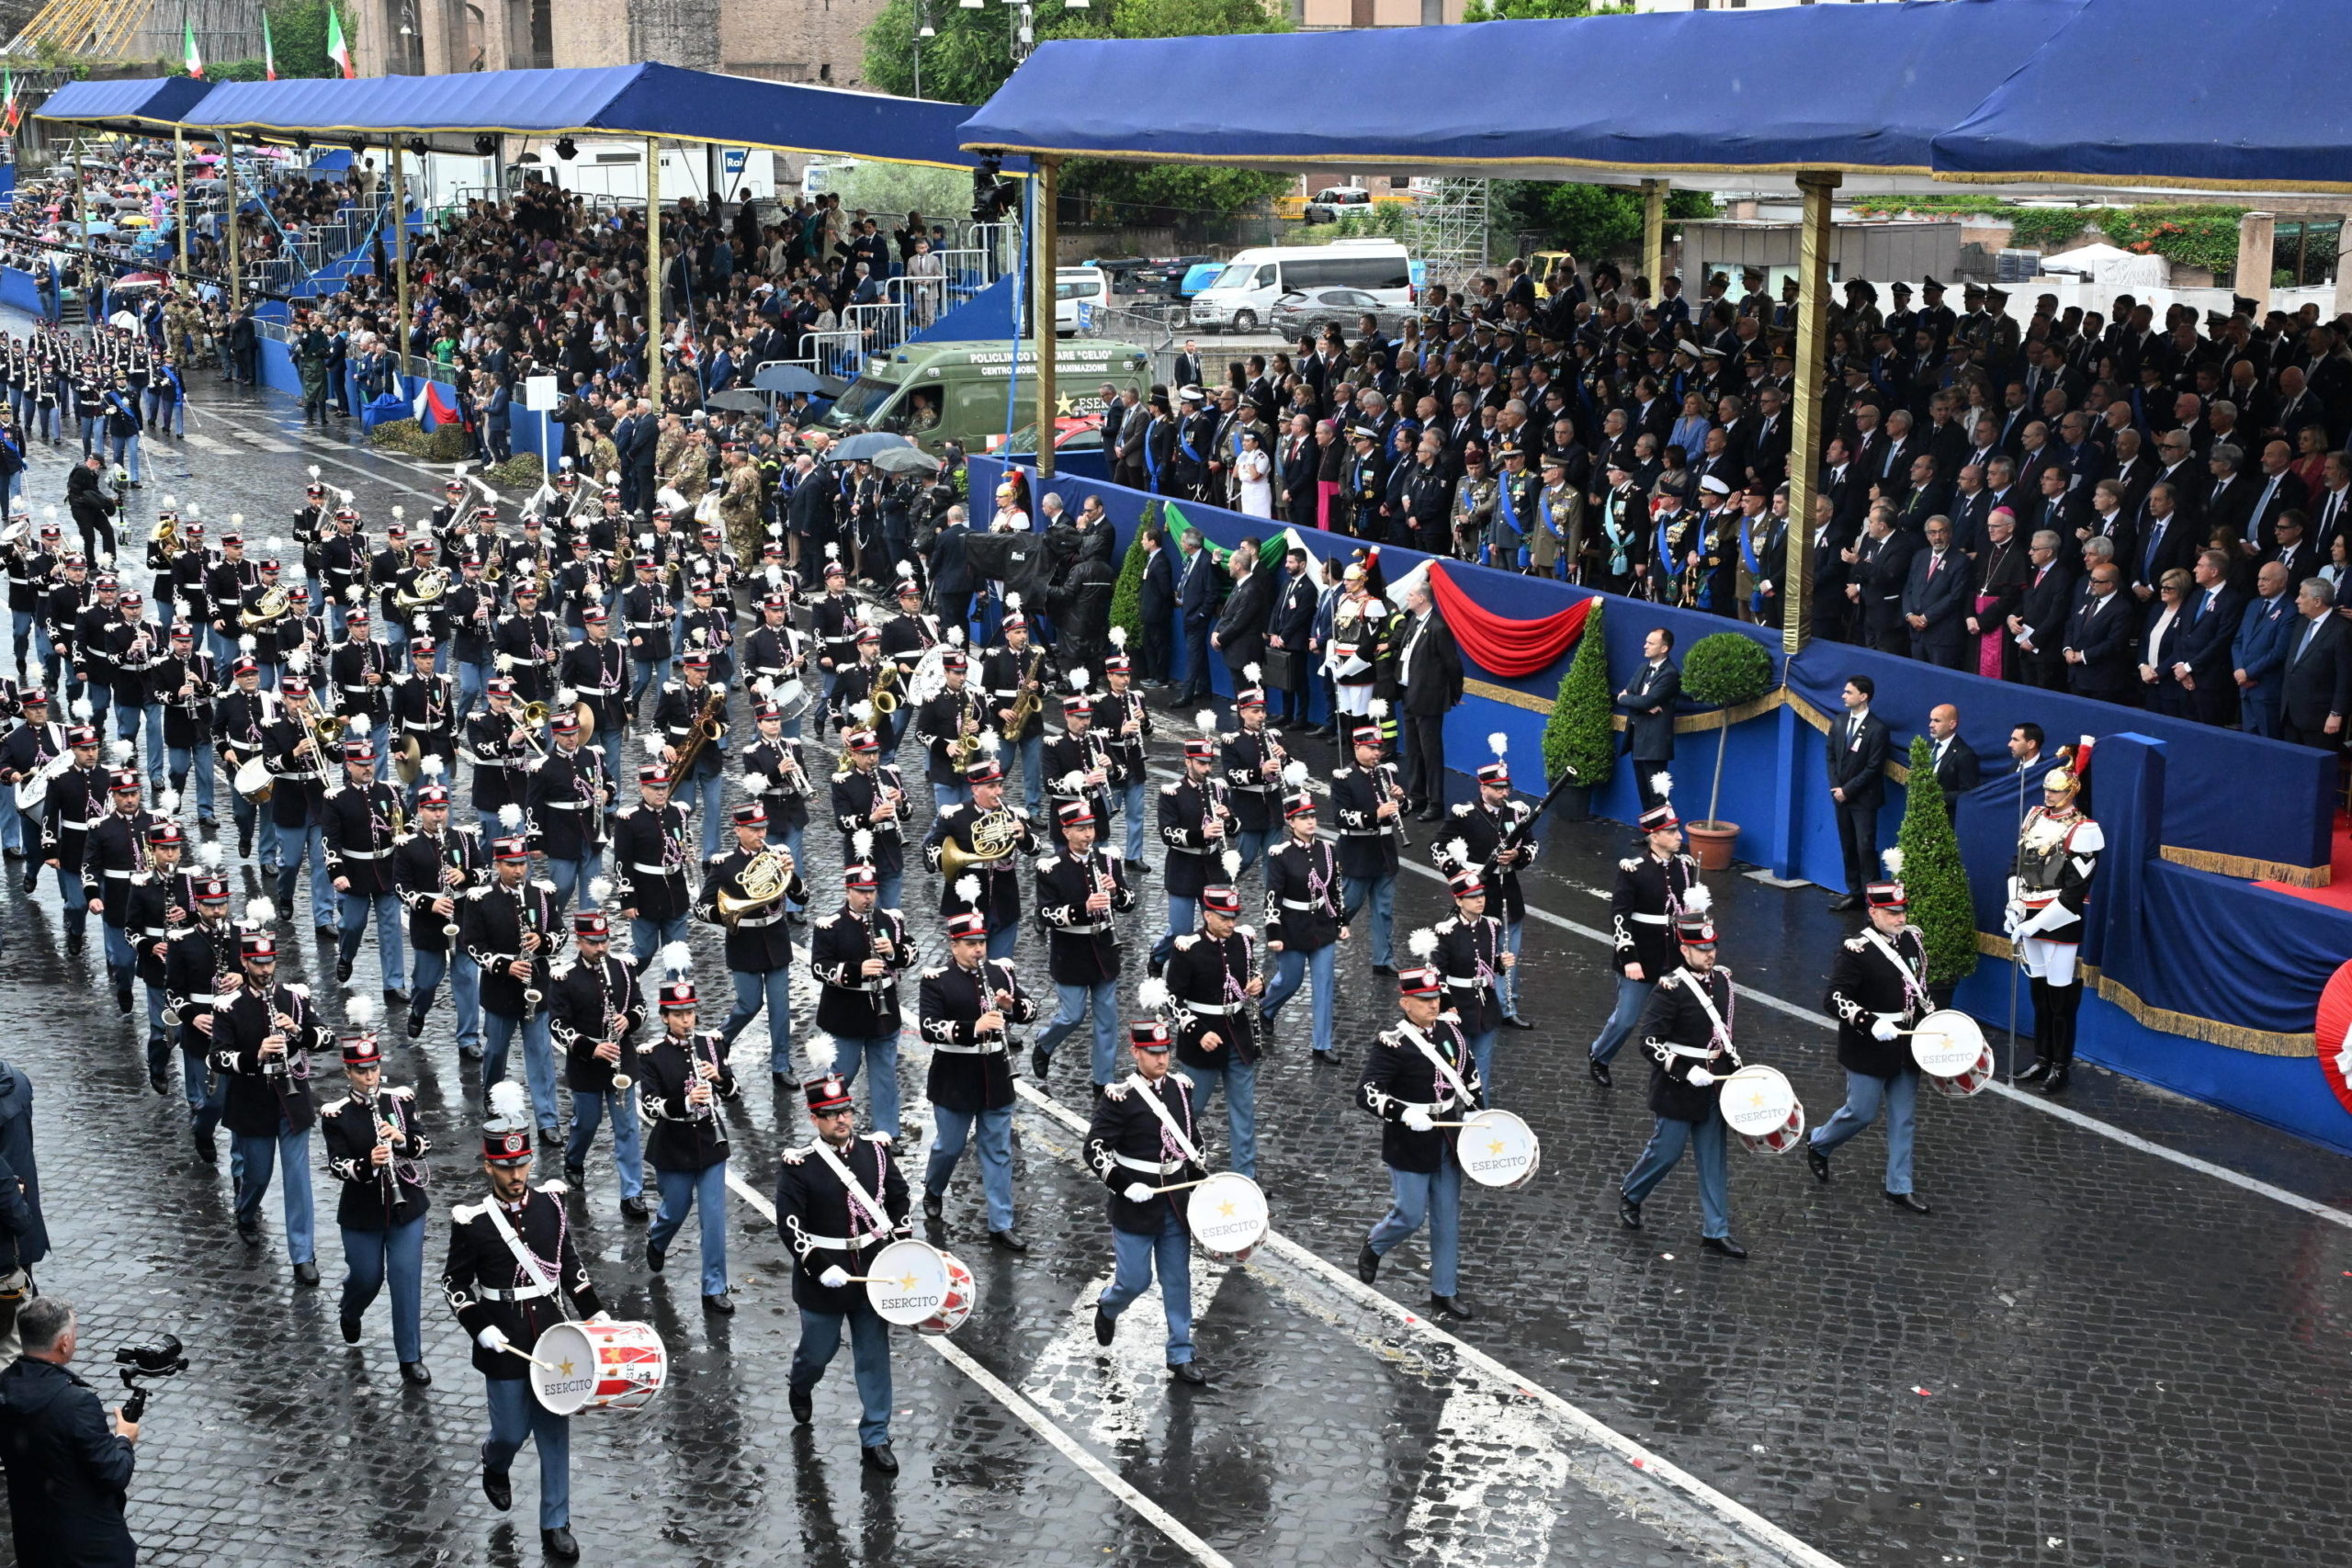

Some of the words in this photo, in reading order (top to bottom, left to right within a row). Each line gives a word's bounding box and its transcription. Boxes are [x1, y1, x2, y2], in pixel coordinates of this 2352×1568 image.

[727, 157, 743, 167] Rai
[809, 175, 825, 186] Rai
[970, 352, 1030, 363] POLICLINCO
[1077, 350, 1113, 360] "CELIO"
[981, 367, 1012, 376] CENTRO
[1015, 366, 1037, 374] MOBIL
[1011, 551, 1025, 561] Rai
[1923, 1053, 1973, 1065] ESERCITO
[1735, 1108, 1786, 1123] ESERCITO
[1472, 1156, 1526, 1172] ESERCITO
[1202, 1220, 1259, 1238] ESERCITO
[881, 1296, 938, 1310] ESERCITO
[545, 1378, 593, 1395] ESERCITO
